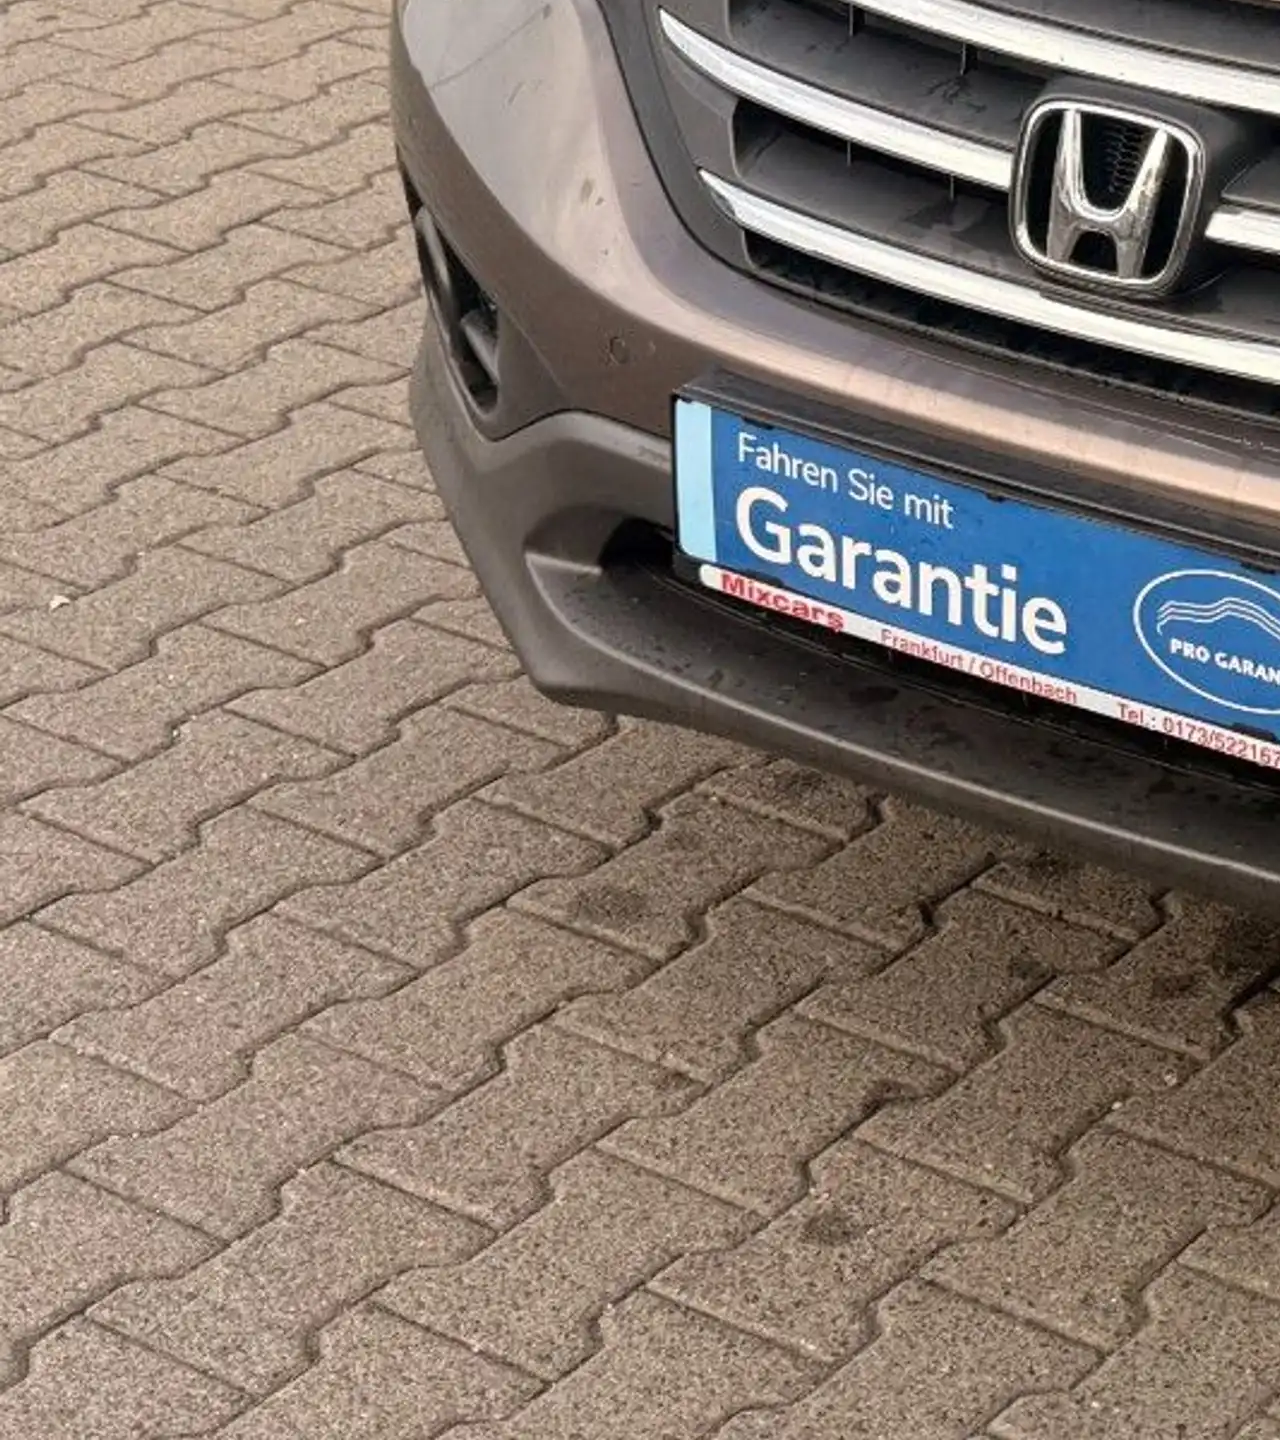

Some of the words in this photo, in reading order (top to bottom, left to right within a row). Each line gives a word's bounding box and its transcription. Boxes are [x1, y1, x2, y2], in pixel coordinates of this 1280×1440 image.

[738, 431, 838, 494] Fahren
[848, 468, 894, 511] Sie
[904, 492, 955, 529] mit
[720, 573, 845, 634] Mixcars
[735, 486, 1067, 655] Garantie
[880, 627, 963, 672] Frankfurt
[980, 659, 1079, 705] Offenbach
[1170, 638, 1211, 664] PRO
